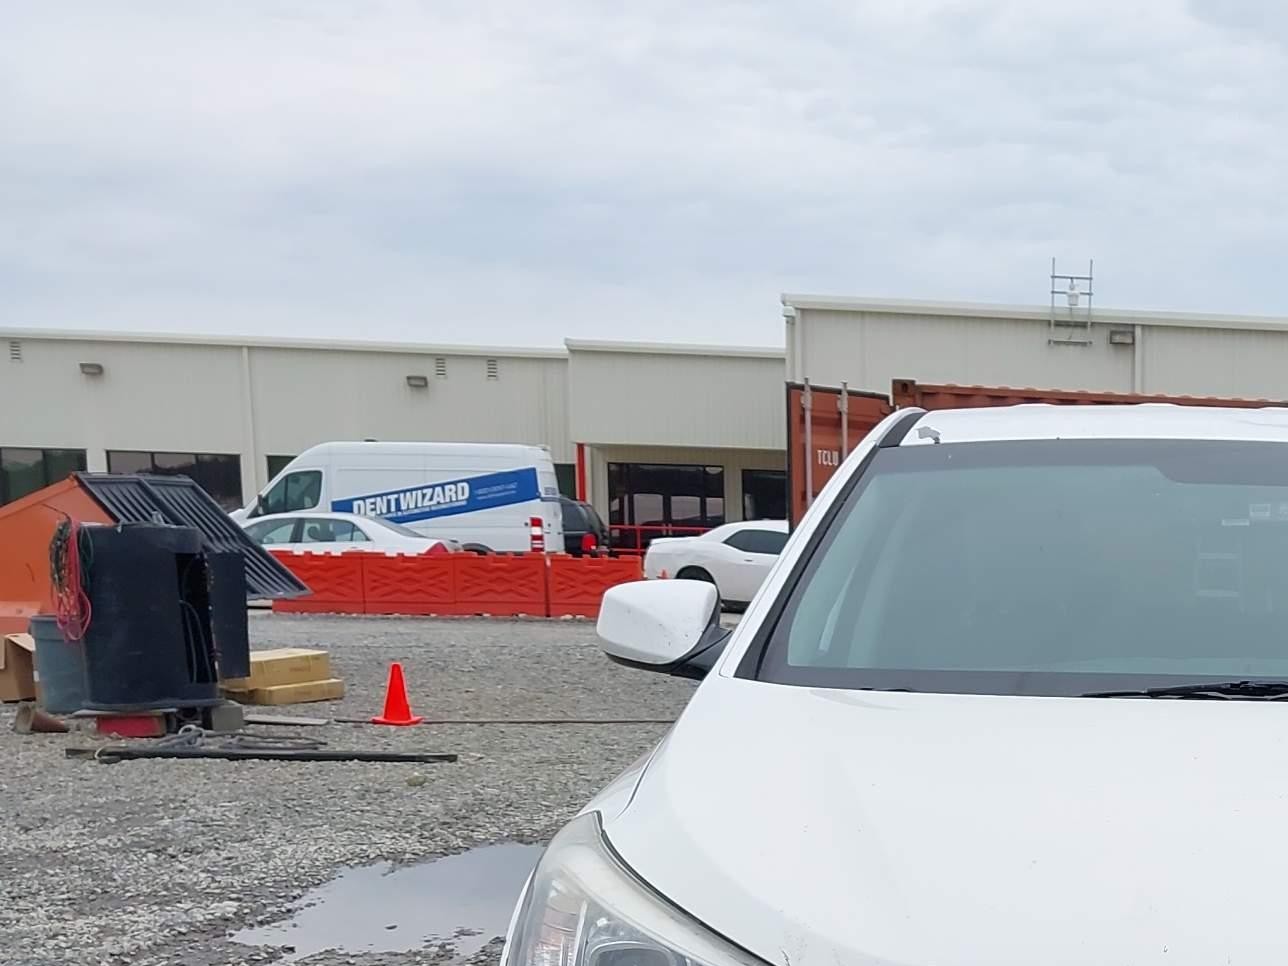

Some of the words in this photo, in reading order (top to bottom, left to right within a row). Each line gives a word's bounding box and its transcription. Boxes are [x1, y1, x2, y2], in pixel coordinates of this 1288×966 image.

[817, 449, 839, 466] TCLU
[352, 494, 399, 516] DENT
[400, 482, 470, 510] WIZARD
